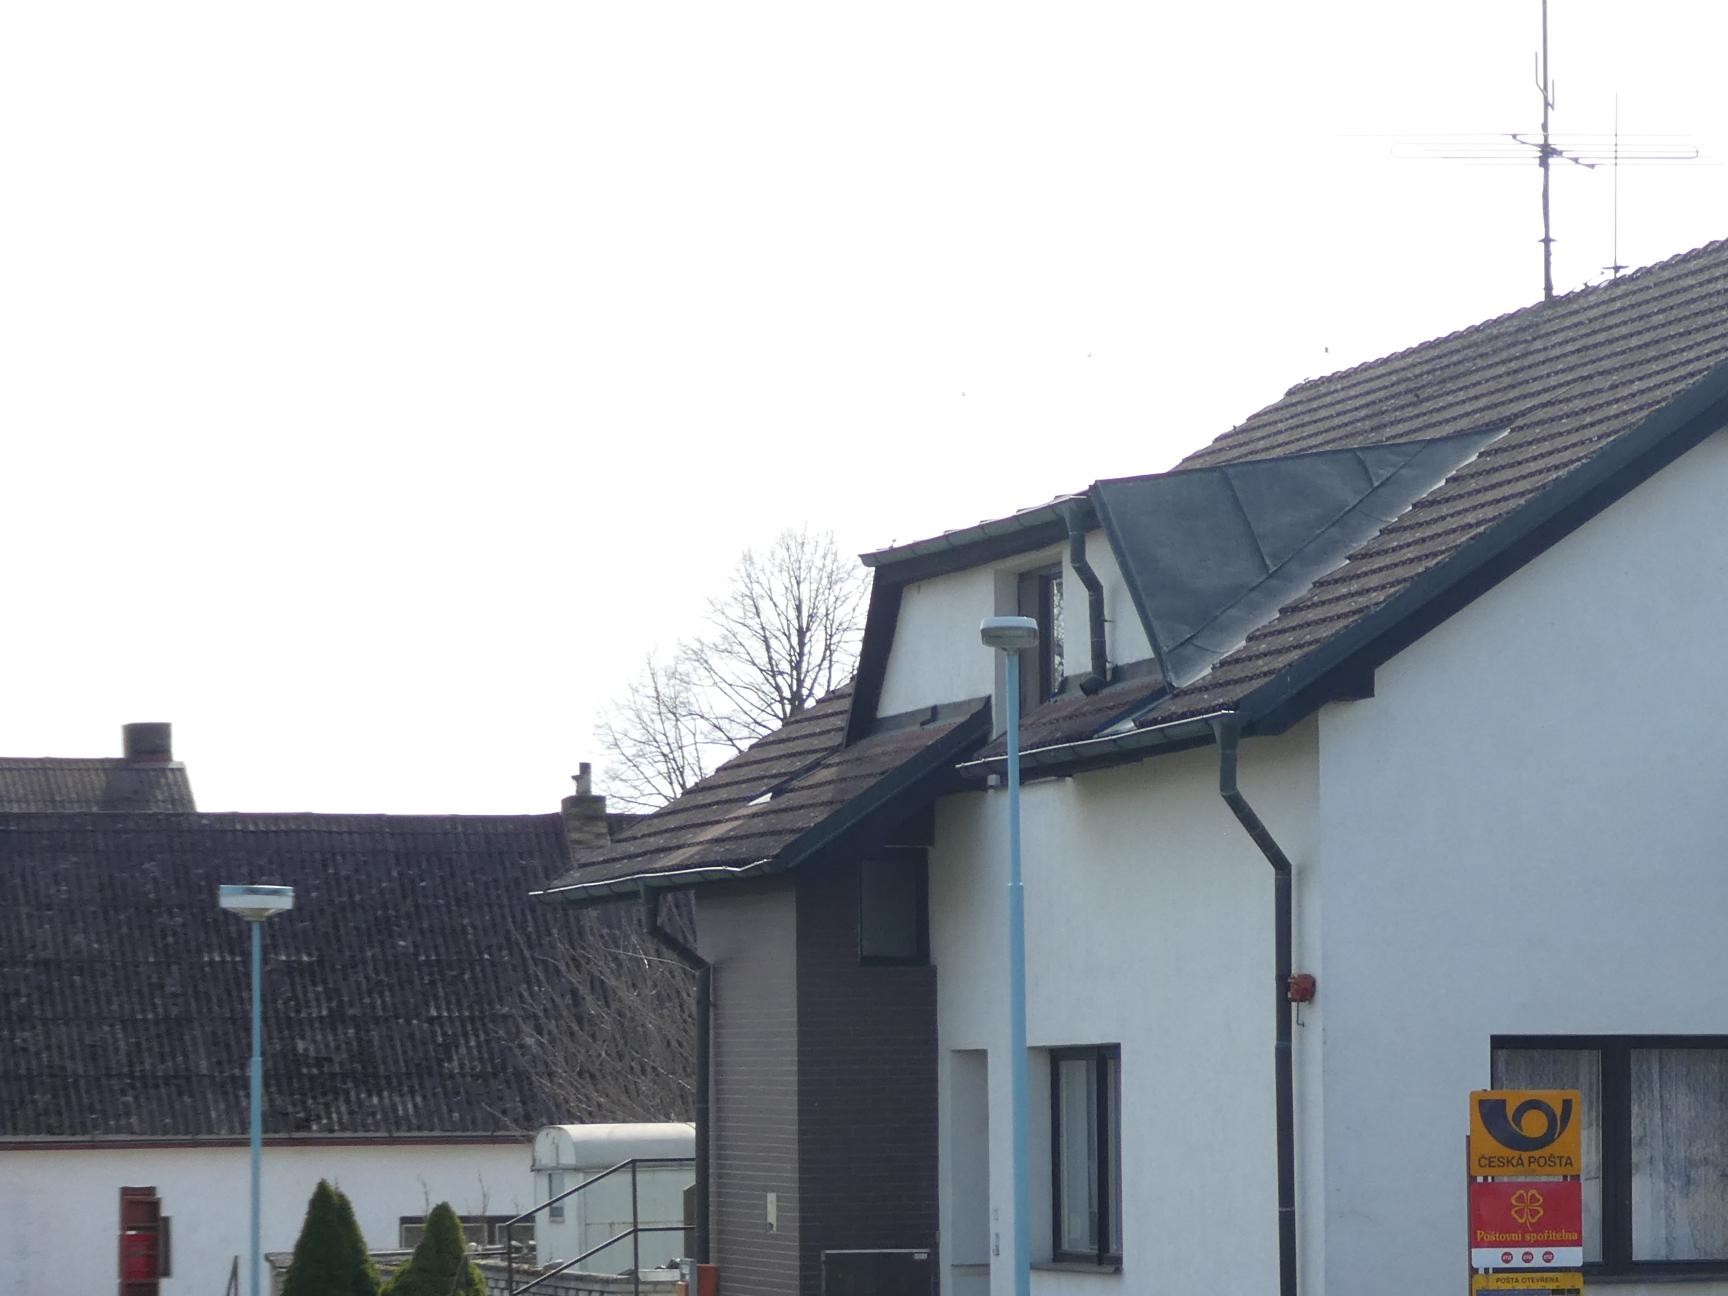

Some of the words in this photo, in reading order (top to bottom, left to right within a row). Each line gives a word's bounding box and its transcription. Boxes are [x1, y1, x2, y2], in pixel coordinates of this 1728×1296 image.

[1478, 1154, 1524, 1168] ČESKÁ
[1528, 1154, 1574, 1168] POŠTA
[1476, 1230, 1521, 1241] Poštovní
[1525, 1229, 1578, 1242] spořitelna
[1495, 1276, 1519, 1284] POŠTA
